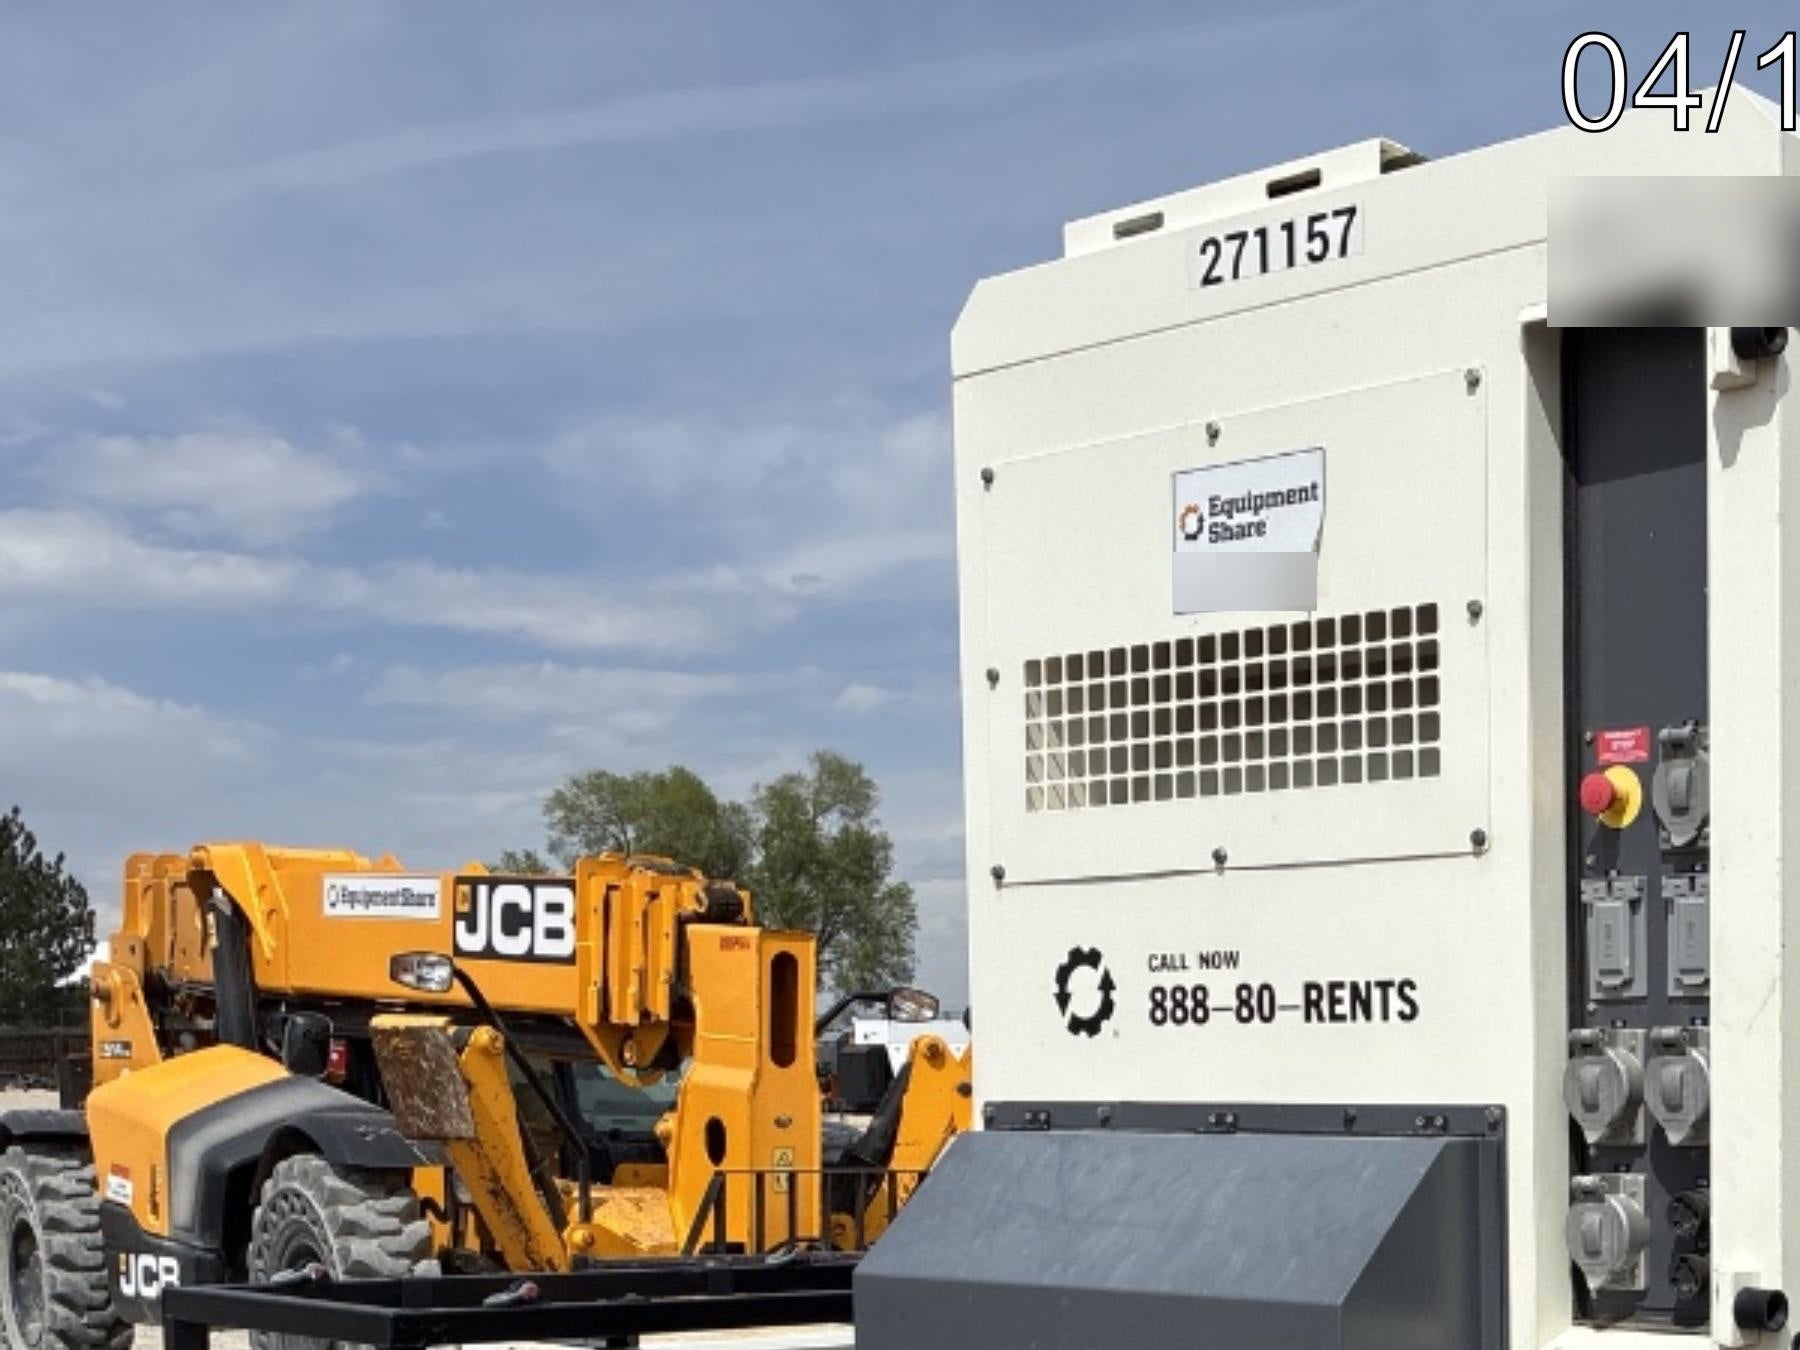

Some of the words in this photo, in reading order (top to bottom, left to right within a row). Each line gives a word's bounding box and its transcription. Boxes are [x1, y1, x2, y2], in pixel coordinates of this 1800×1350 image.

[1200, 205, 1357, 286] 271157
[1208, 481, 1318, 518] Equipment
[1208, 519, 1266, 543] Share
[456, 883, 576, 956] JCB
[1149, 953, 1188, 970] CALL
[1200, 950, 1240, 969] NOW
[1149, 978, 1419, 1026] 888-80-RENTS
